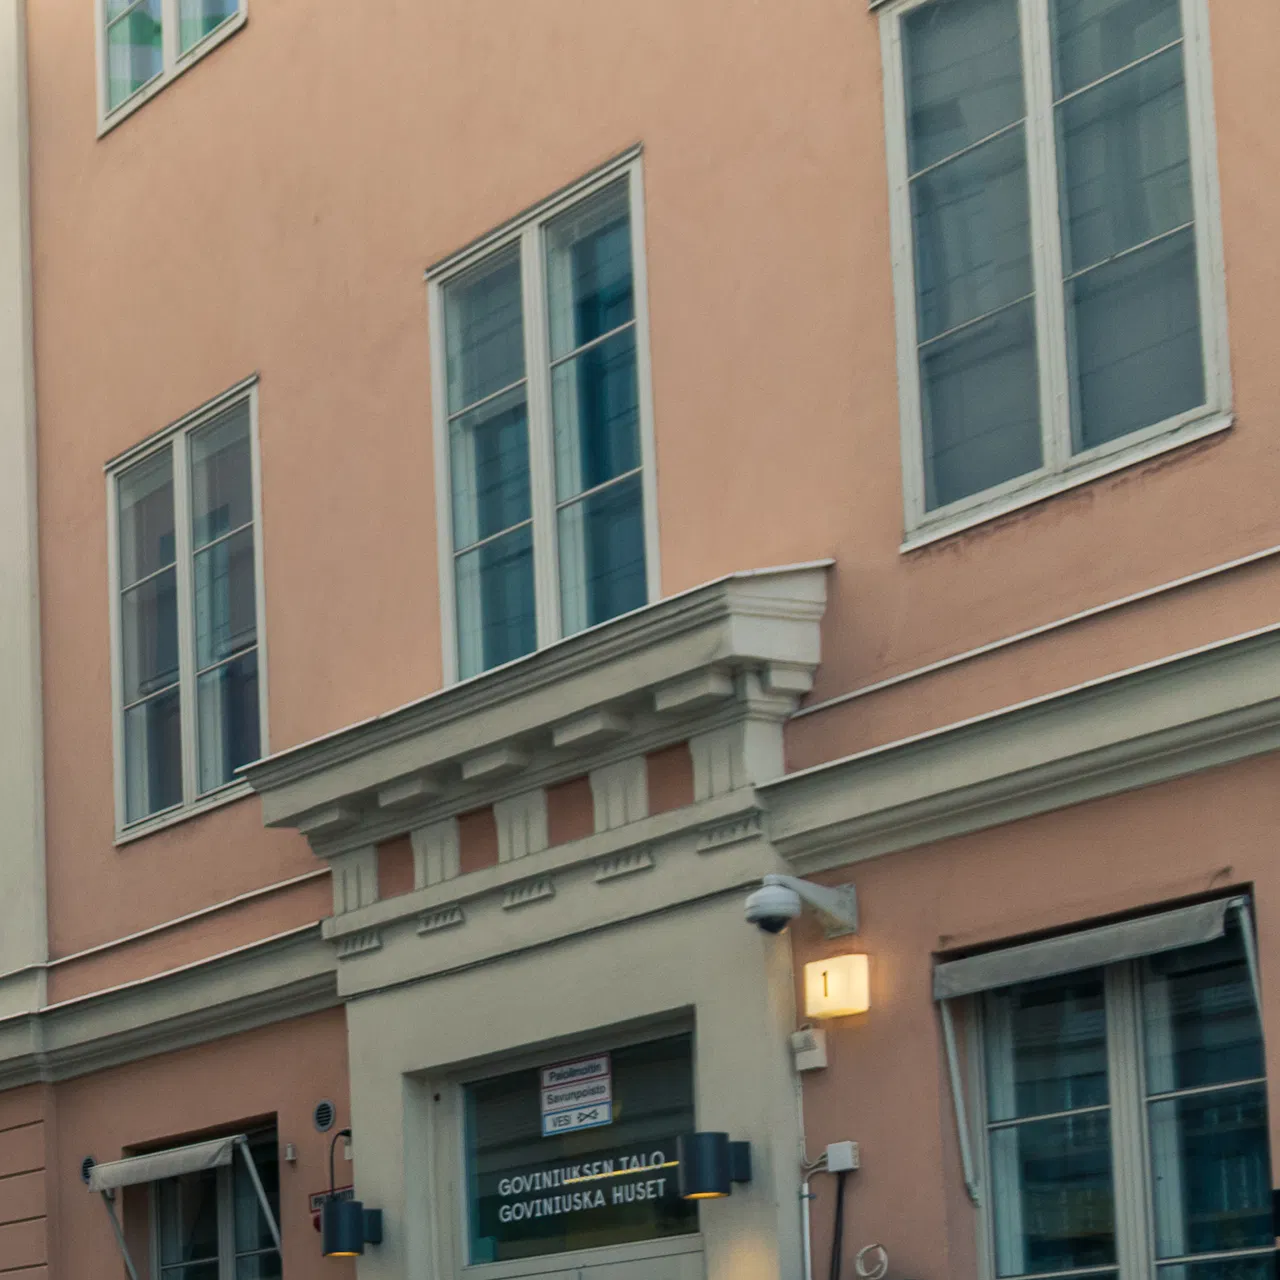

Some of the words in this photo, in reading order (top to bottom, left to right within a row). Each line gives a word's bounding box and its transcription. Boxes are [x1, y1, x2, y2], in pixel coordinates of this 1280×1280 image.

[547, 1085, 606, 1104] Savunpoisto
[552, 1114, 572, 1128] VESI
[498, 1161, 613, 1198] GOVINIUKSEN
[620, 1151, 665, 1174] TALO
[498, 1189, 607, 1224] GOVINIUSKA
[612, 1178, 667, 1206] HUSET
